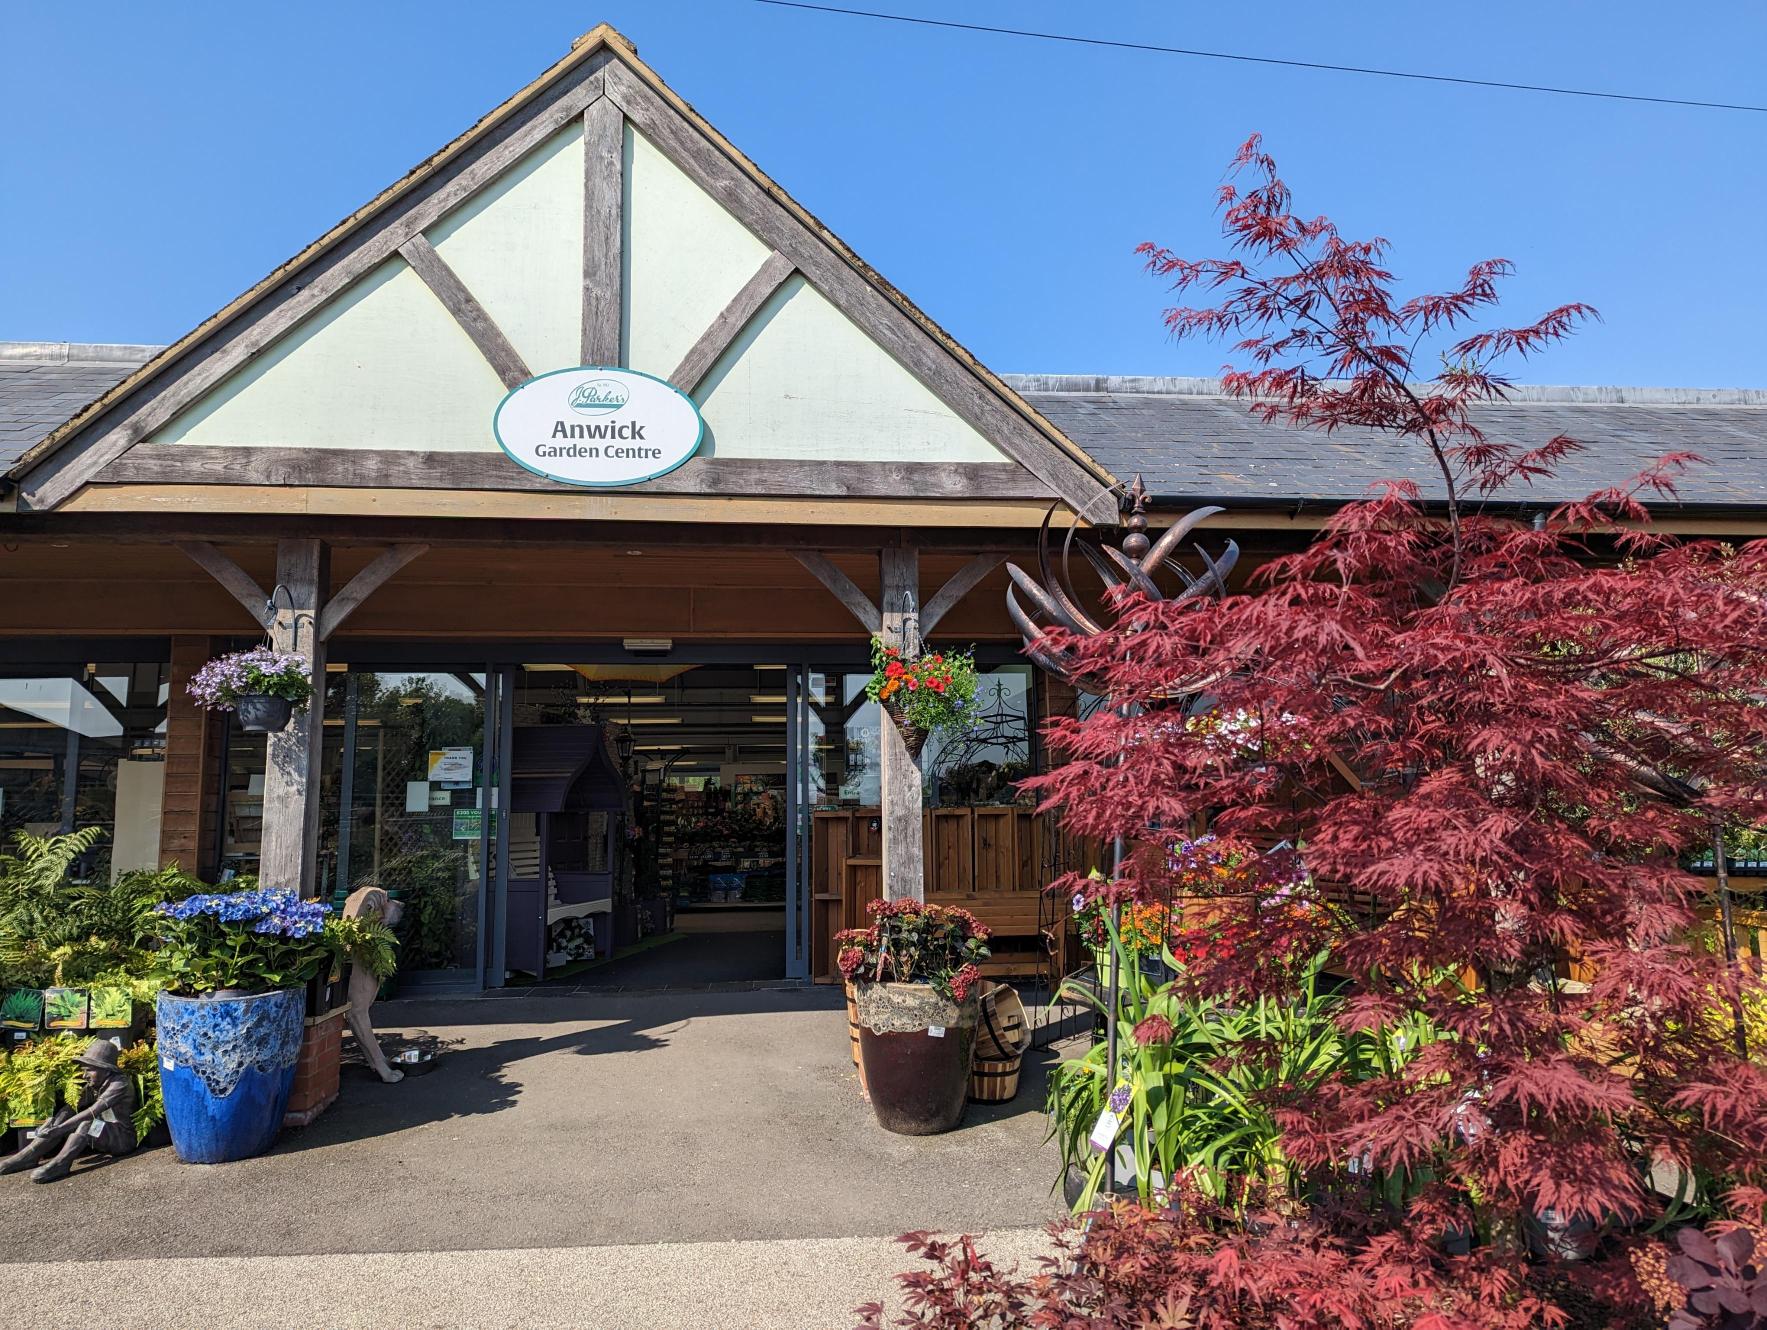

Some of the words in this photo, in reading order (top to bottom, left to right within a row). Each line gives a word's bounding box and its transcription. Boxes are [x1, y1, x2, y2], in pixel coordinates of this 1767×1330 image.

[551, 420, 646, 440] Anwick
[534, 444, 599, 458] Garden
[604, 445, 662, 459] Centre
